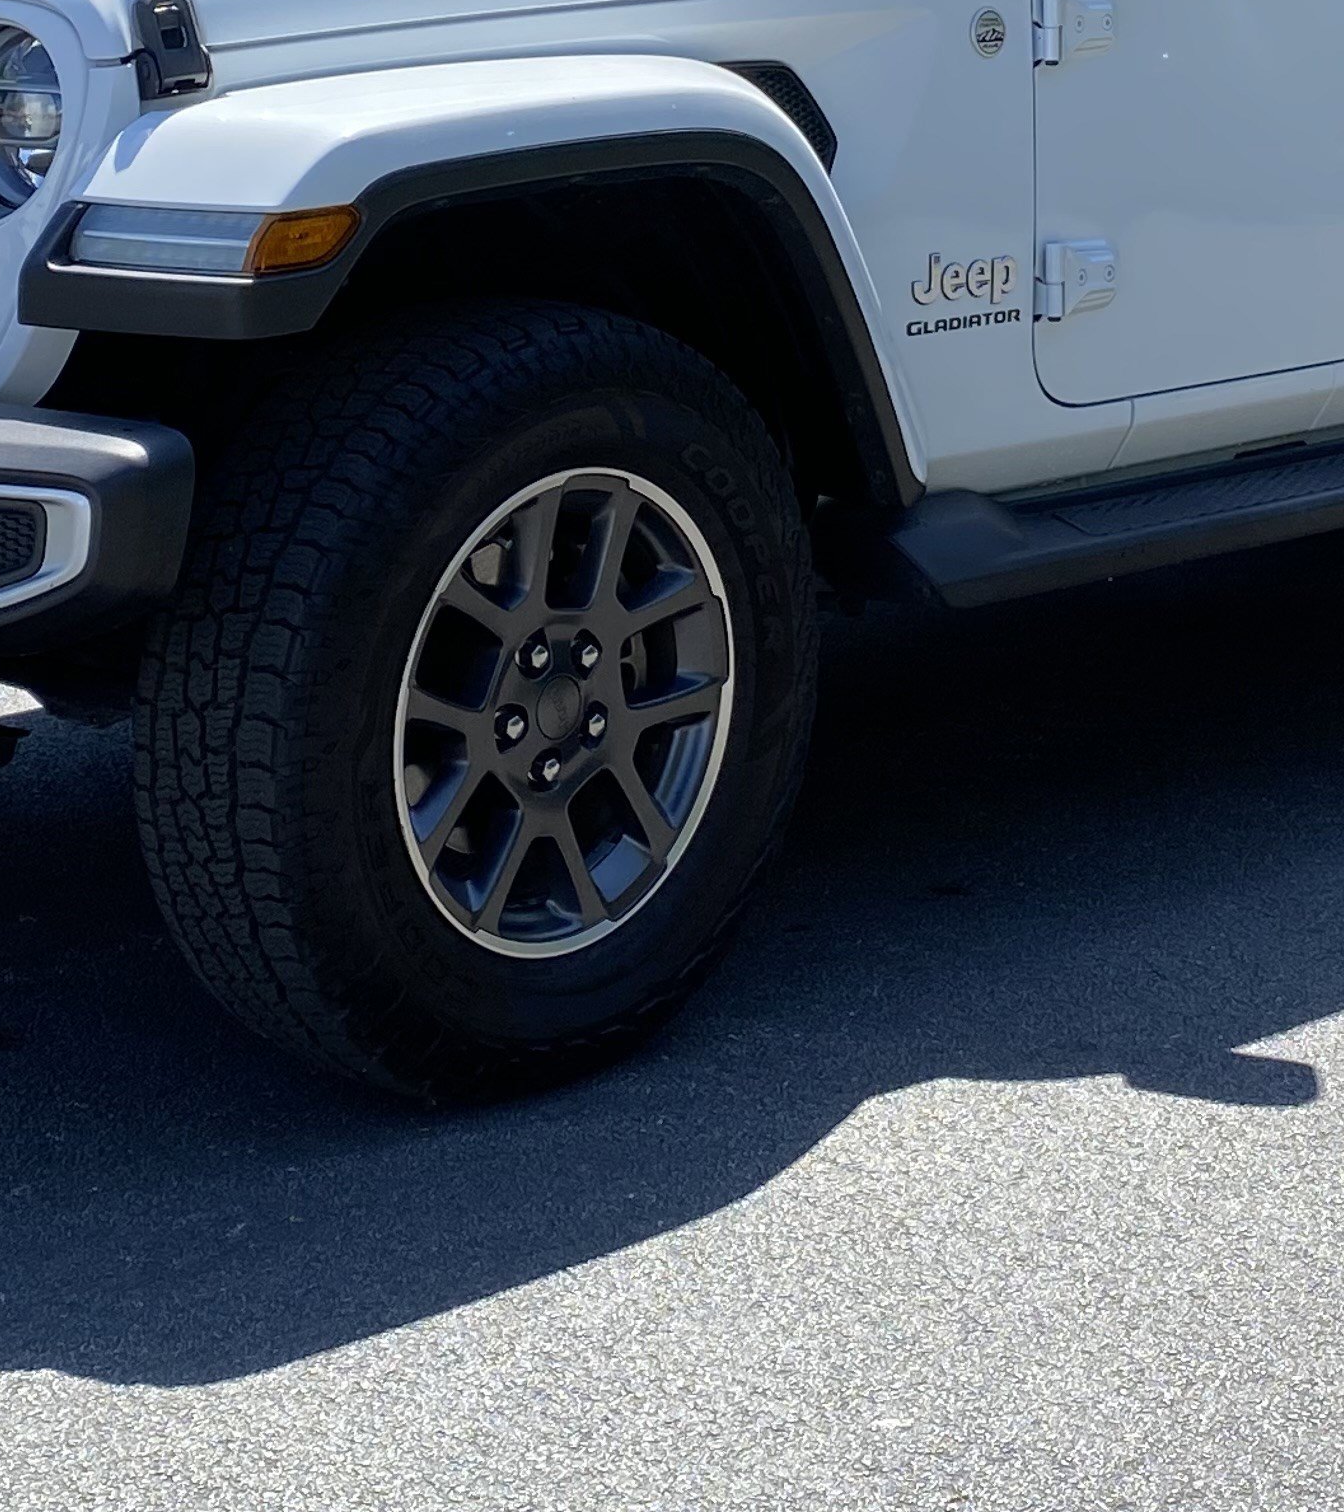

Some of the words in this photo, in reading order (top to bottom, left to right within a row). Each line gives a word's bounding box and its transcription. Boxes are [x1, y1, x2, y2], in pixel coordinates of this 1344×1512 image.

[911, 252, 1018, 306] Jeep
[906, 308, 1021, 337] GLADIATOR
[680, 442, 785, 652] COOPER
